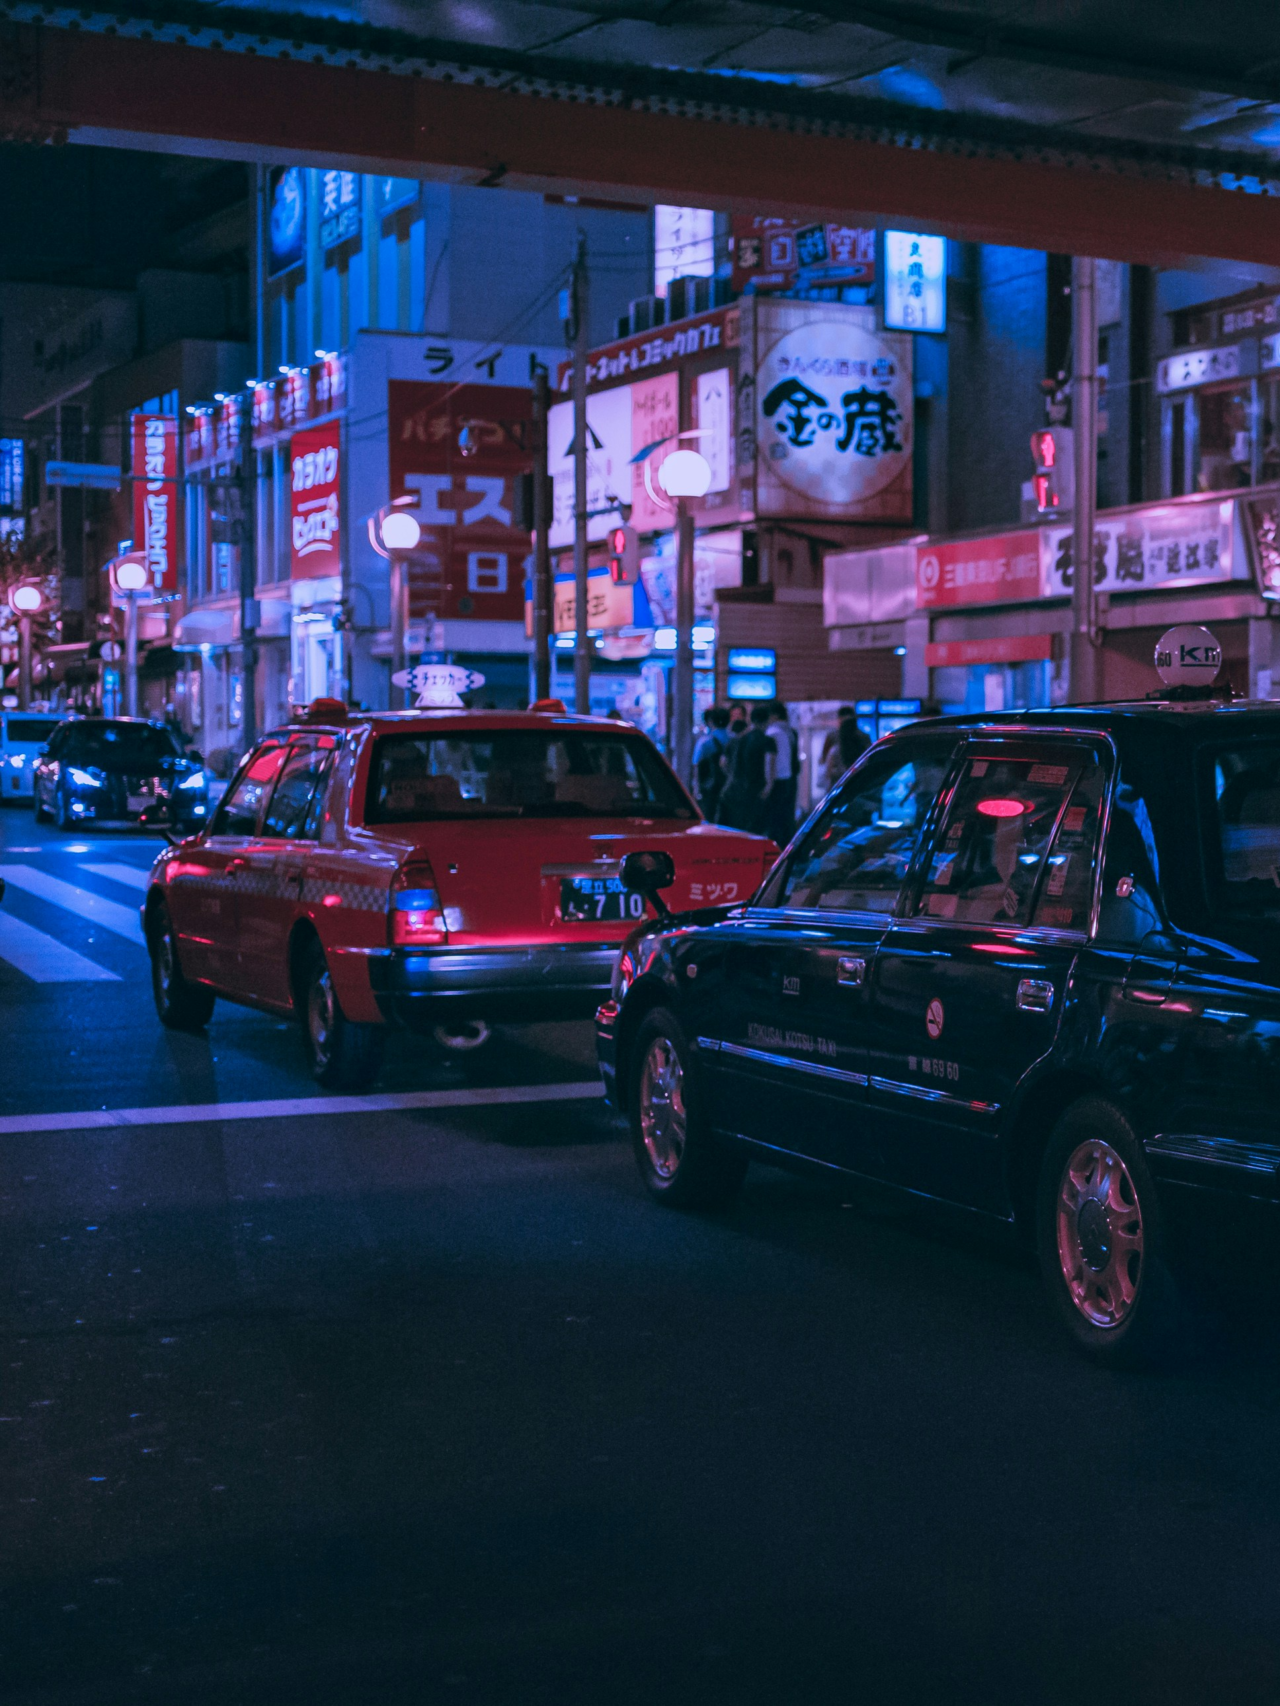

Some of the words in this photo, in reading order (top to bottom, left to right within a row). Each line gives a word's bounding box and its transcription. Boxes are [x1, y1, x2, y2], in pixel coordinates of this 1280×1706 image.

[763, 376, 903, 457] 金の蔵
[292, 446, 339, 492] カラオケ
[403, 472, 512, 528] エス
[422, 671, 463, 686] チェッカー
[689, 882, 738, 901] ミツワ
